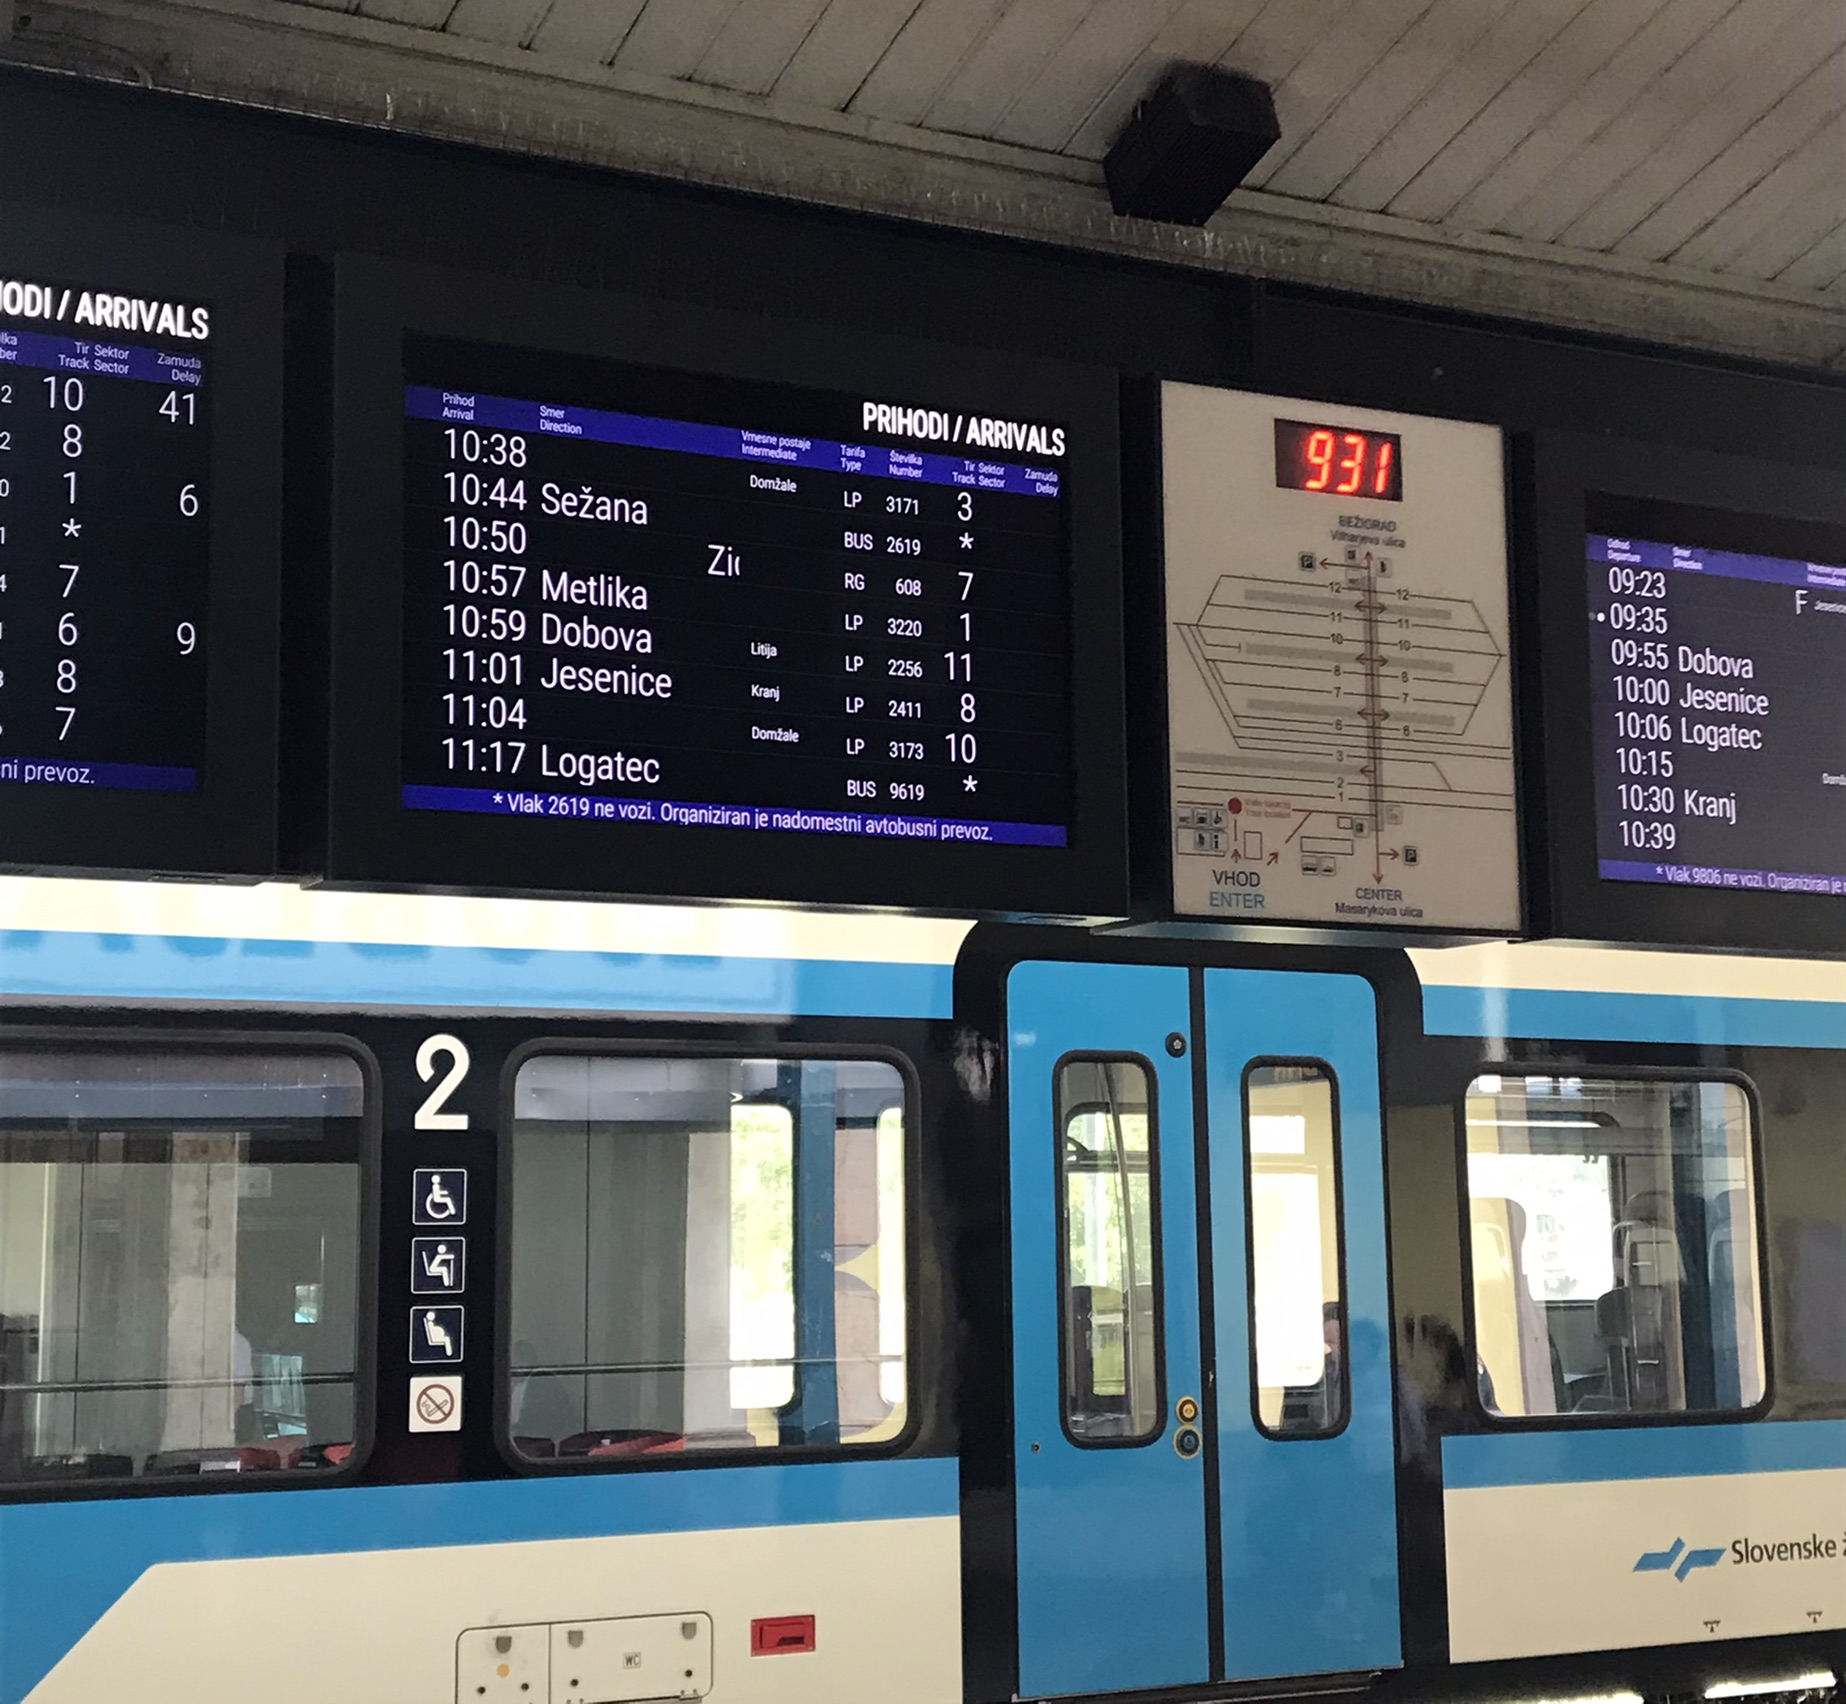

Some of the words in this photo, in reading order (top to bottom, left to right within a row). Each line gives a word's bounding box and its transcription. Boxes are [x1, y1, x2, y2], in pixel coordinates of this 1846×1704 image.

[0, 281, 51, 319] ODI
[56, 289, 71, 321] /
[74, 292, 209, 340] ARRIVALS
[58, 354, 90, 370] Track
[74, 341, 90, 355] Tir
[94, 343, 130, 360] Sektor
[157, 352, 202, 369] Zamuda
[93, 359, 130, 375] Sector
[171, 368, 202, 386] Delay
[43, 376, 84, 411] 10
[158, 390, 195, 425] 41
[442, 392, 475, 407] Prihod
[442, 406, 474, 421] Arrival
[539, 405, 565, 419] Smer
[62, 423, 83, 458] 8
[539, 419, 582, 435] Direction
[741, 429, 777, 446] Vmesne
[779, 435, 810, 451] postaje
[863, 402, 949, 441] PRIHODI
[953, 415, 963, 442] /
[966, 416, 1065, 456] ARRIVALS
[444, 428, 527, 468] 10:38
[741, 443, 797, 461] Intermediate
[1304, 429, 1393, 494] 931
[840, 458, 861, 472] Type
[889, 464, 922, 478] Number
[952, 472, 976, 486] Track
[1025, 468, 1058, 483] Zamuda
[63, 471, 77, 504] 1
[444, 472, 527, 511] 10:44
[750, 474, 797, 493] Domžale
[978, 475, 1005, 489] Sector
[179, 483, 199, 517] 6
[541, 483, 648, 525] Sežana
[843, 491, 862, 508] LP
[886, 496, 919, 515] 3171
[957, 492, 973, 521] 3
[443, 516, 527, 554] 10:50
[844, 532, 873, 550] BUS
[886, 537, 921, 555] 2619
[59, 564, 80, 598] 7
[443, 560, 526, 597] 10:57
[542, 570, 648, 610] Metlika
[844, 573, 865, 590] RG
[895, 579, 921, 596] 608
[957, 572, 974, 600] 7
[1608, 566, 1666, 599] 09:23
[58, 612, 78, 646] 6
[443, 604, 526, 641] 10:59
[845, 613, 863, 631] LP
[888, 618, 922, 637] 3220
[960, 612, 971, 641] 1
[1609, 602, 1668, 634] 09:35
[176, 621, 196, 655] 9
[542, 613, 652, 653] Dobova
[751, 641, 777, 658] Litija
[845, 655, 864, 672] LP
[1611, 638, 1669, 670] 09:55
[1678, 645, 1754, 679] Dobova
[56, 659, 77, 694] 8
[442, 648, 522, 686] 11:01
[540, 657, 672, 698] Jesenice
[888, 659, 923, 677] 2256
[944, 651, 971, 682] 11
[751, 684, 780, 702] Kranj
[846, 696, 864, 713] LP
[1613, 675, 1670, 706] 10:00
[1679, 682, 1769, 716] Jesenice
[442, 693, 527, 730] 11:04
[888, 701, 921, 718] 2411
[960, 693, 976, 723] 8
[55, 706, 77, 741] 7
[751, 726, 799, 743] Domžale
[1614, 711, 1672, 741] 10:06
[1681, 717, 1763, 752] Logatec
[442, 737, 526, 774] 11:17
[846, 738, 865, 755] LP
[889, 742, 924, 760] 3173
[945, 733, 977, 763] 10
[24, 765, 95, 784] prevoz.
[542, 744, 660, 786] Logatec
[1616, 747, 1674, 777] 10:15
[847, 779, 876, 797] BUS
[889, 783, 925, 801] 9619
[1617, 784, 1675, 814] 10:30
[507, 793, 544, 814] Vlak
[548, 796, 590, 816] 2619
[594, 801, 614, 816] ne
[618, 802, 655, 820] vozi.
[660, 803, 750, 828] Organiziran
[754, 808, 769, 830] je
[773, 810, 861, 832] nadomestni
[866, 818, 937, 838] avtobusni
[941, 823, 993, 841] prevoz.
[1684, 789, 1736, 825] Kranj
[1619, 820, 1676, 850] 10:39
[1212, 869, 1260, 887] VHOD
[1665, 866, 1691, 882] Vlak
[1692, 867, 1721, 884] 9806
[1724, 873, 1738, 885] ne
[1767, 872, 1829, 892] Organiziran
[1209, 891, 1265, 909] ENTER
[1355, 888, 1402, 901] CENTER
[1335, 902, 1400, 917] Masarykova
[1403, 905, 1423, 918] ulica
[414, 1033, 469, 1130] 2
[1731, 1533, 1837, 1564] Slovenske
[625, 1654, 640, 1666] WC
